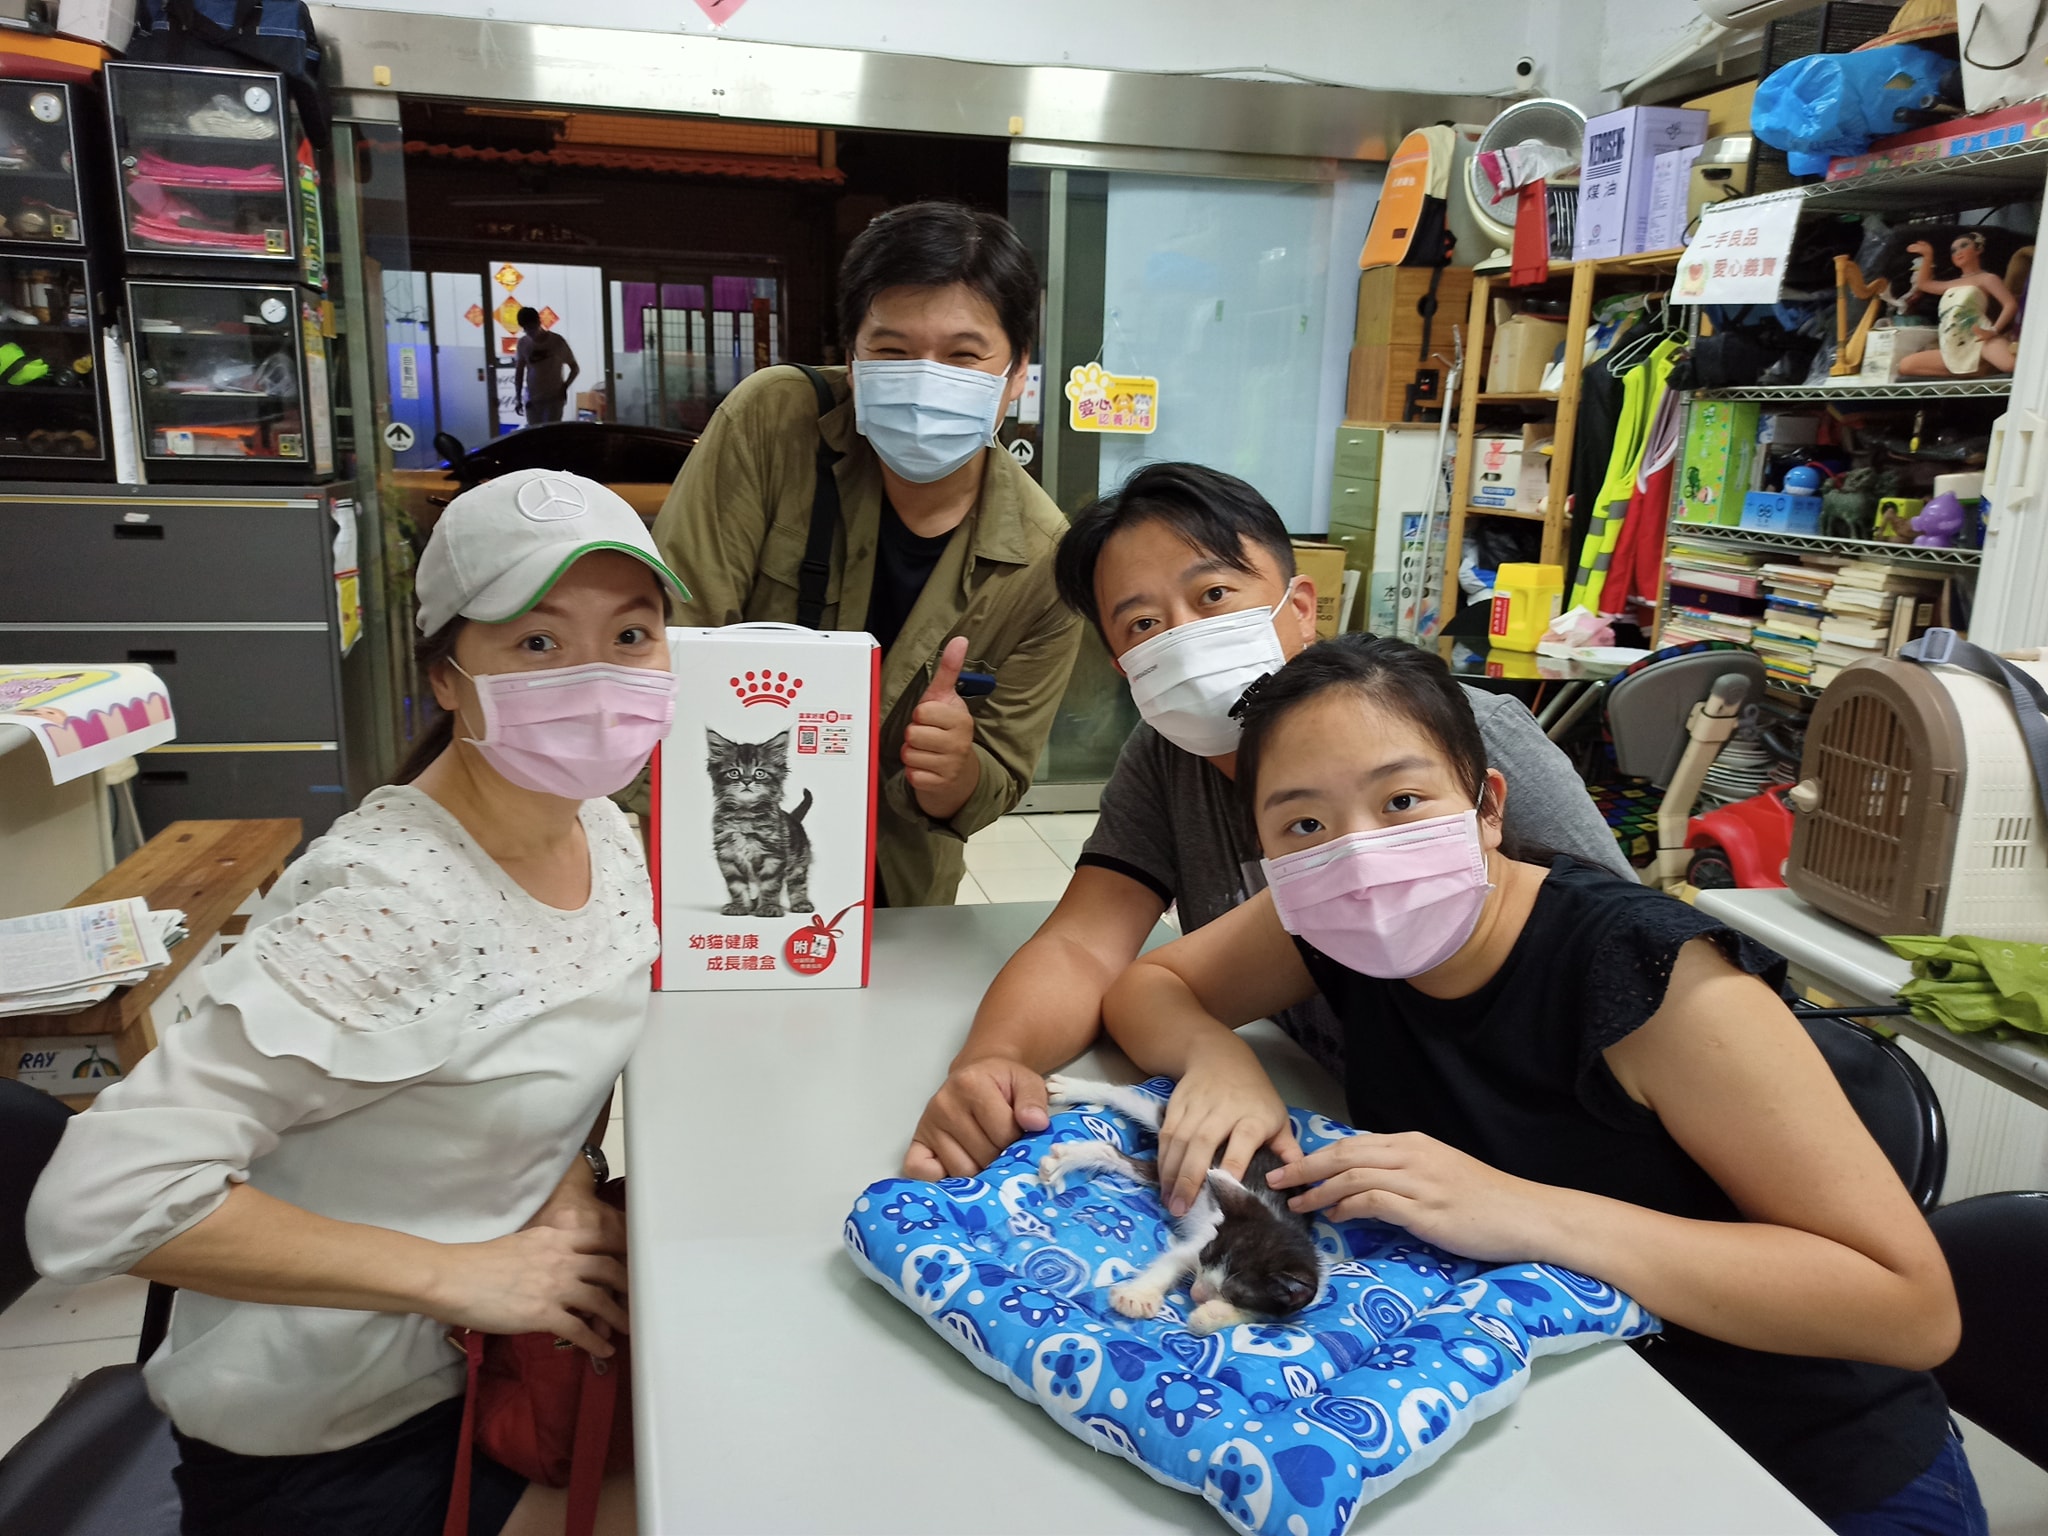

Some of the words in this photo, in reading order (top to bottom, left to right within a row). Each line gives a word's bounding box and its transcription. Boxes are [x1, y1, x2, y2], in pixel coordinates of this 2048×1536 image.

[1587, 181, 1617, 200] 煤油
[1700, 228, 1758, 249] 二手良品
[1712, 257, 1777, 279] 愛心義賣
[689, 934, 759, 950] 幼貓健康
[793, 940, 809, 954] 附
[706, 955, 776, 971] 成長禮盒
